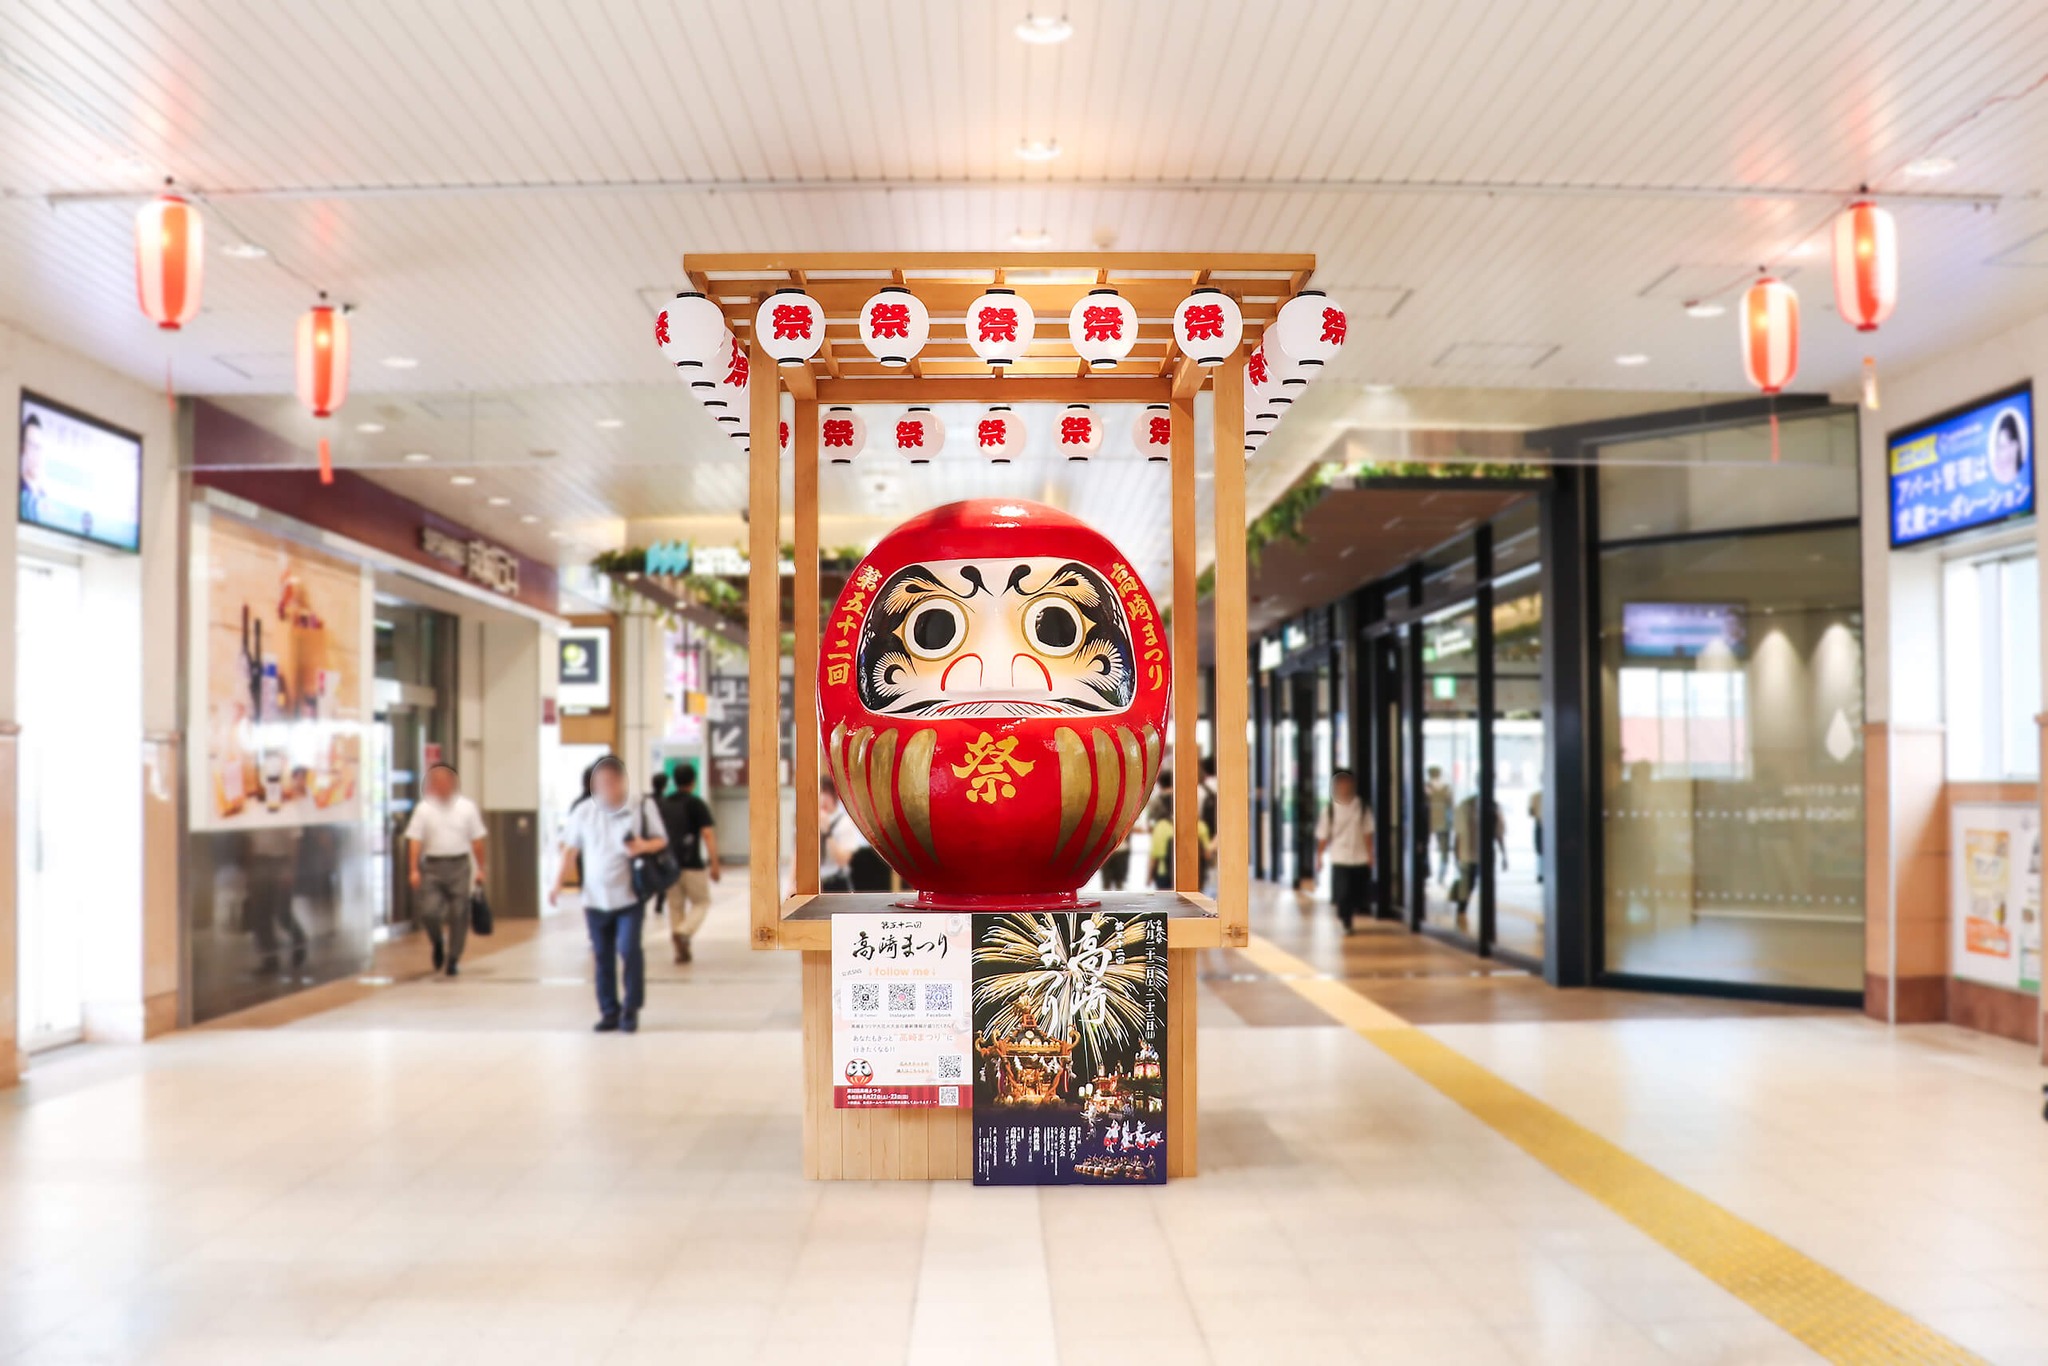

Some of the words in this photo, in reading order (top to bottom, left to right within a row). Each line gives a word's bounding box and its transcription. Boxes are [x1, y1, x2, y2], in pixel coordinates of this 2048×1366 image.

[772, 304, 814, 341] 祭
[870, 303, 911, 339] 祭
[979, 307, 1019, 343] 祭
[1083, 306, 1124, 342] 祭
[1184, 304, 1225, 341] 祭
[1320, 307, 1347, 346] 祭
[823, 419, 854, 447] 祭
[896, 421, 924, 448] 祭
[978, 419, 1006, 447] 祭
[1061, 417, 1092, 445] 祭
[827, 565, 883, 687] 第五十二回
[1110, 562, 1164, 691] 高崎まつり
[951, 731, 1035, 804] 祭
[852, 931, 948, 961] 高崎まつり
[875, 967, 909, 976] follow
[913, 968, 930, 976] me
